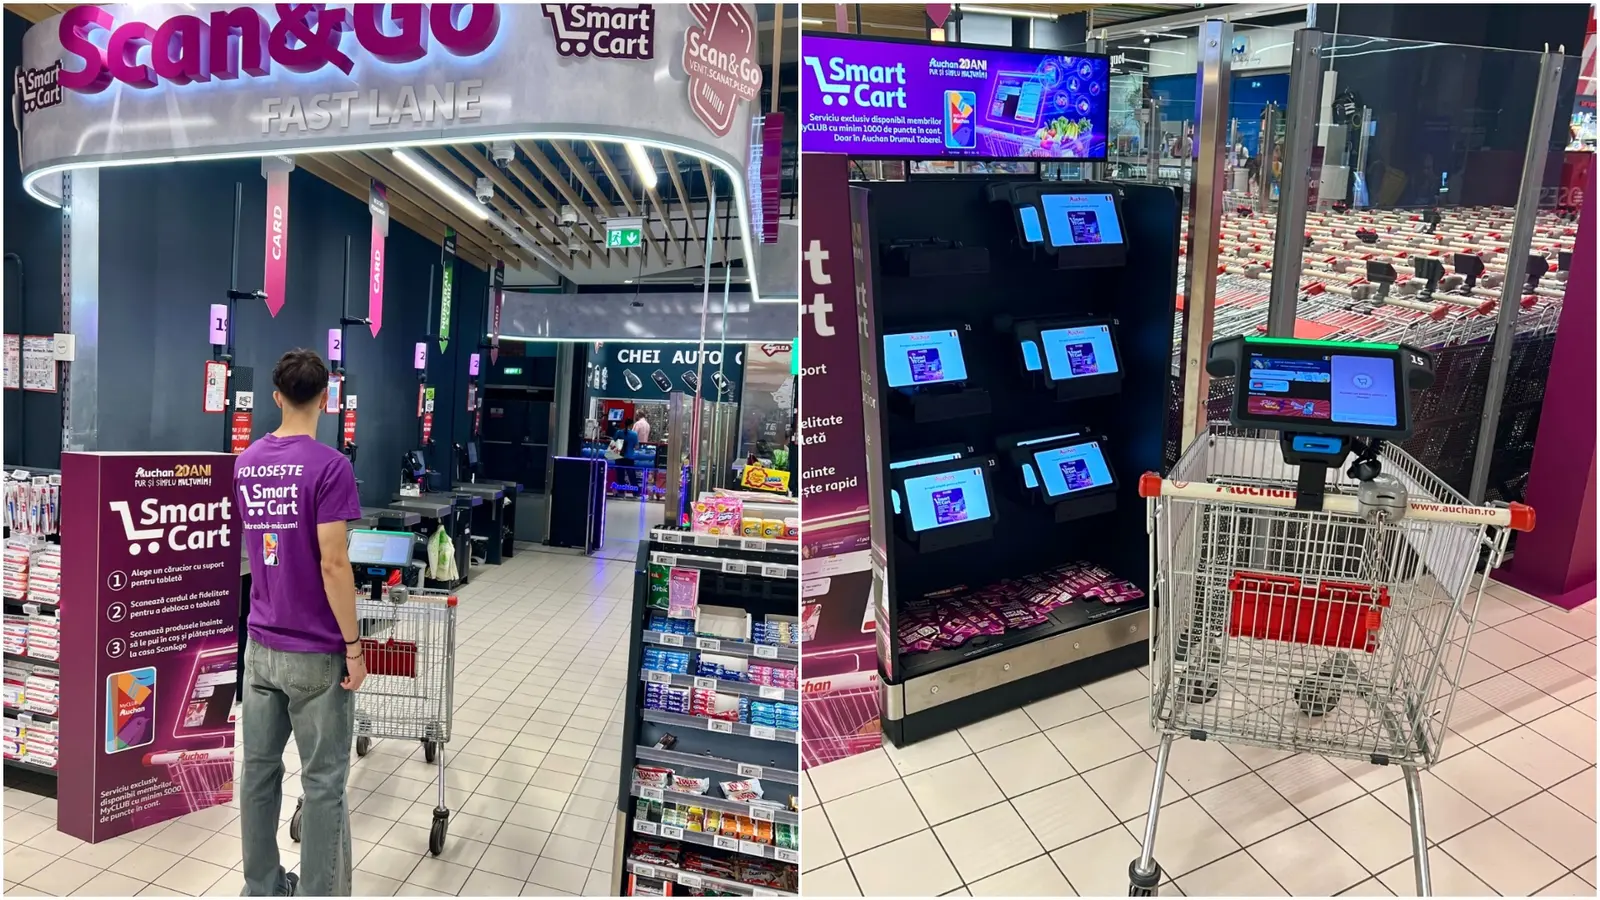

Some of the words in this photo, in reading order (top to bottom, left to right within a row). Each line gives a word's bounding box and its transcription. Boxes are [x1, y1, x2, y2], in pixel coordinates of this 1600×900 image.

[570, 5, 650, 31] Smart
[58, 3, 500, 93] Scan&Go
[593, 31, 648, 55] Cart
[689, 32, 759, 85] Scan&Go
[929, 57, 958, 69] Auchan
[28, 64, 60, 91] Smart
[829, 57, 906, 84] Smart
[37, 85, 60, 106] Cart
[854, 84, 907, 108] Cart
[261, 91, 359, 133] FAST
[368, 80, 483, 126] LANE
[809, 113, 840, 122] Serviciu
[840, 114, 870, 122] exclusiv
[871, 115, 906, 124] disponibil
[839, 124, 863, 132] minim
[893, 127, 917, 136] puncte
[834, 134, 852, 142] Doar
[861, 135, 888, 143] Auchan
[890, 135, 915, 143] Drumul
[916, 136, 943, 144] Taberei.
[272, 205, 283, 261] CARD
[373, 250, 381, 295] CARD
[617, 349, 661, 364] CHEI
[672, 350, 722, 365] AUTO
[1410, 354, 1424, 366] 15
[135, 467, 174, 478] Auchan
[237, 465, 304, 480] FOLOSEȘTE
[135, 479, 147, 487] PUR
[252, 483, 298, 499] Smart
[610, 482, 638, 491] Auchan
[825, 476, 857, 492] rapid
[140, 497, 231, 525] Smart
[267, 500, 298, 516] Cart
[1411, 503, 1496, 516] www.auchan.ro
[168, 524, 231, 551] Cart
[131, 569, 152, 578] Alege
[164, 564, 192, 574] cărucior
[203, 561, 224, 570] suport
[113, 574, 121, 587] 1
[131, 580, 155, 588] pentru
[157, 575, 182, 583] tabletă
[130, 597, 164, 608] Scanează
[166, 594, 188, 603] cardul
[199, 589, 229, 599] fidelitate
[112, 606, 121, 618] 2
[130, 609, 154, 619] pentru
[161, 604, 189, 614] debloca
[196, 599, 220, 609] tabletă
[130, 627, 164, 638] Scanează
[165, 624, 199, 636] produsele
[140, 639, 147, 647] le
[147, 637, 160, 646] pui
[217, 625, 234, 635] rapid
[112, 641, 121, 654] 3
[129, 650, 137, 658] la
[120, 706, 145, 716] Auchan
[178, 752, 208, 761] Auchan
[101, 786, 129, 798] Serviciu
[130, 776, 158, 789] exclusiv
[101, 793, 135, 806] disponibil
[137, 781, 172, 795] membrilor
[100, 802, 130, 815] MyCLUB
[140, 793, 162, 803] minim
[164, 786, 181, 796] 5000
[110, 809, 134, 822] puncte
[144, 801, 161, 809] cont.
